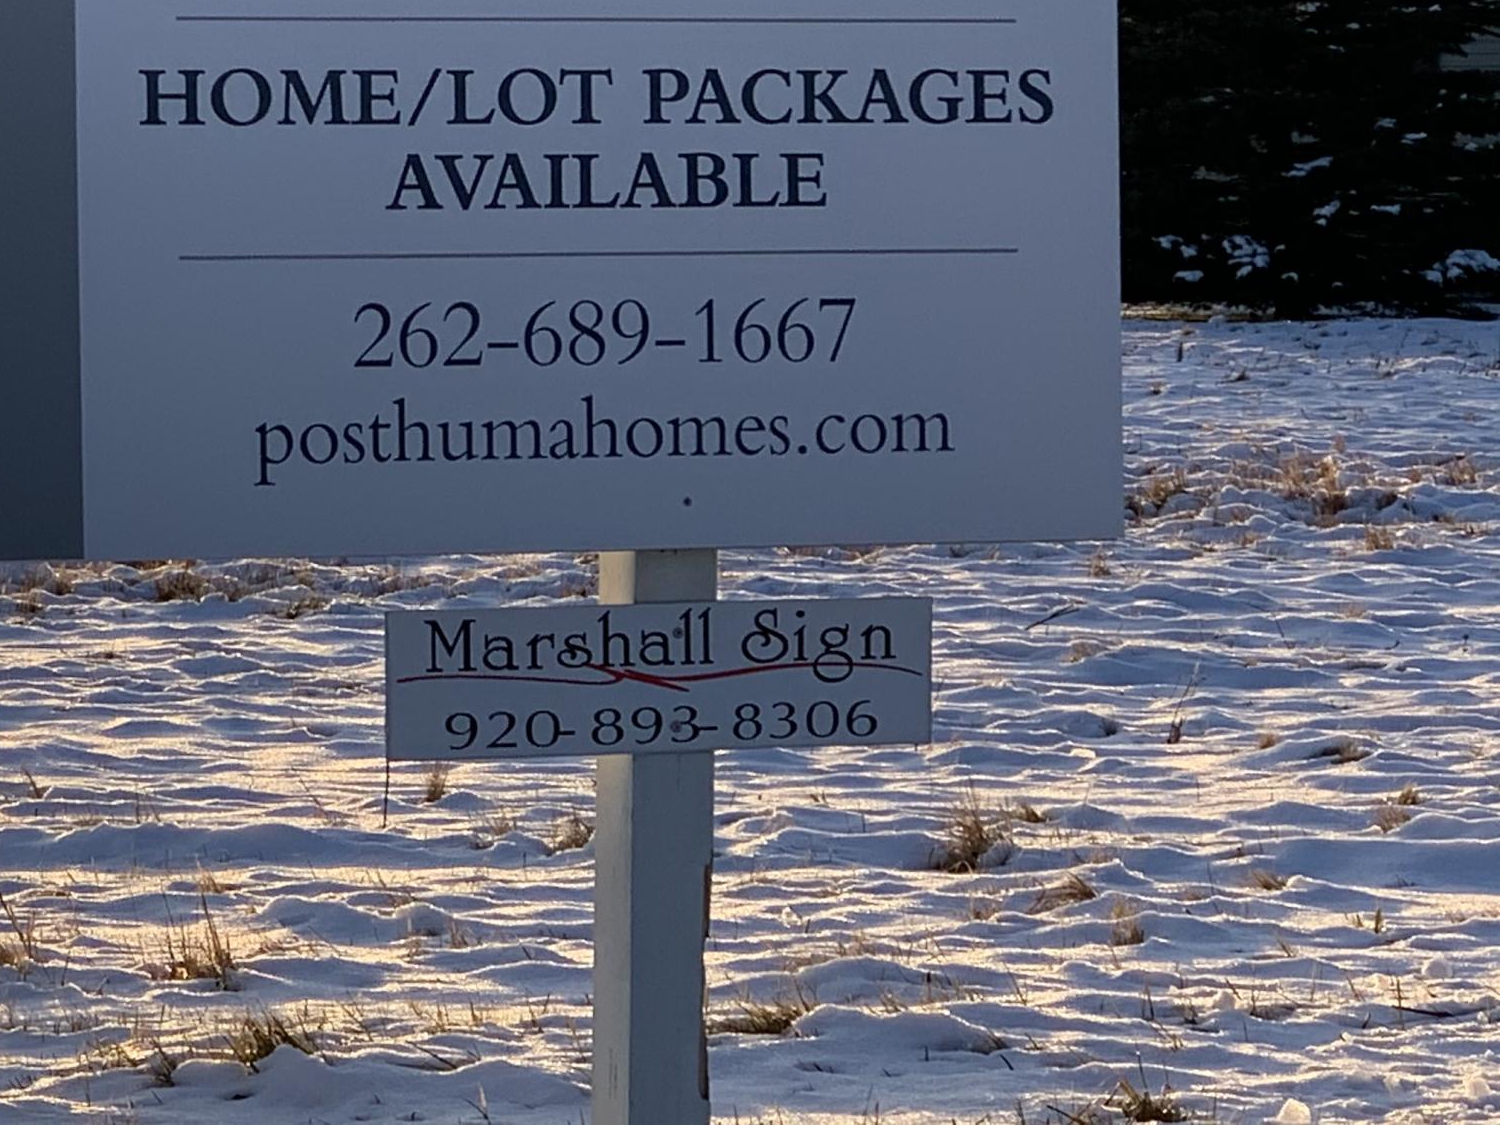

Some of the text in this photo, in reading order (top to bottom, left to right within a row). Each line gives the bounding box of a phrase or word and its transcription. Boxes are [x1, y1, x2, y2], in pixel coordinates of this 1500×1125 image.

[138, 68, 1055, 128] HOME/LOT PACKAGES
[386, 152, 828, 211] AVAILABLE
[352, 297, 857, 369] 262-689-1667
[254, 395, 954, 486] posthumahomes.com
[425, 607, 896, 683] Marshall Sign
